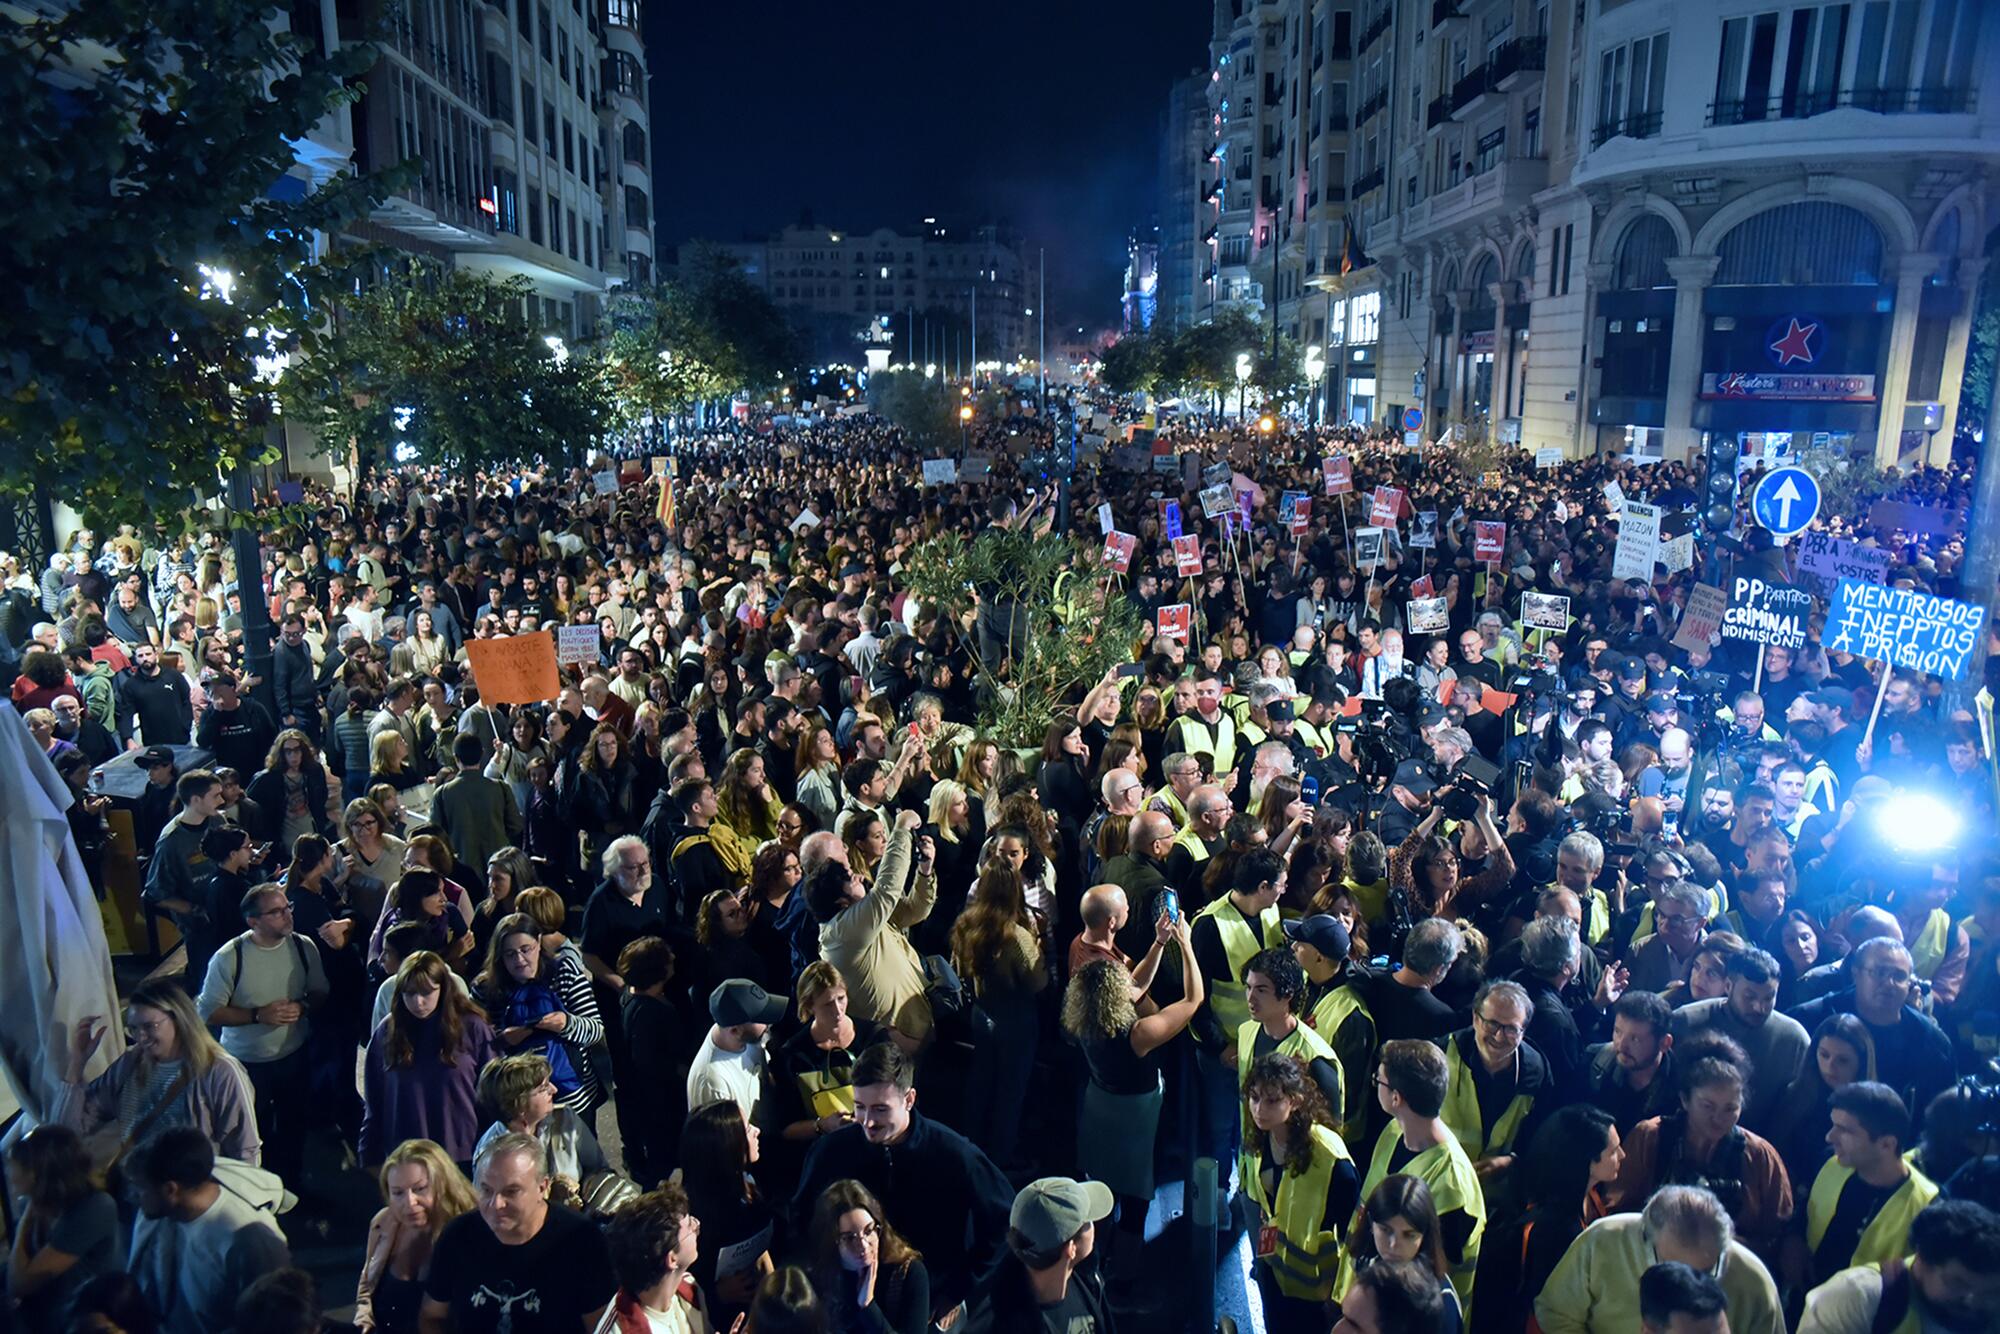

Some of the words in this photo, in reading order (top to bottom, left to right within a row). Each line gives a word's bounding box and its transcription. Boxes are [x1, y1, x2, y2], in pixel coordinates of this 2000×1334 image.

[1731, 373, 1775, 388] Foster's
[1780, 377, 1865, 392] HOLLYWOOD
[1627, 504, 1653, 517] VALENCIA
[1804, 533, 1828, 556] PER
[1830, 540, 1839, 557] A
[1802, 554, 1816, 567] EL
[1833, 560, 1880, 584] VOSTRE
[1735, 577, 1764, 602] PP
[1725, 602, 1806, 636] CRIMINAL
[1843, 583, 1984, 630] MENTIROSOS
[1838, 606, 1975, 653] INEPPTOS
[1831, 627, 1853, 652] A
[1856, 632, 1961, 680] PRISIÓN
